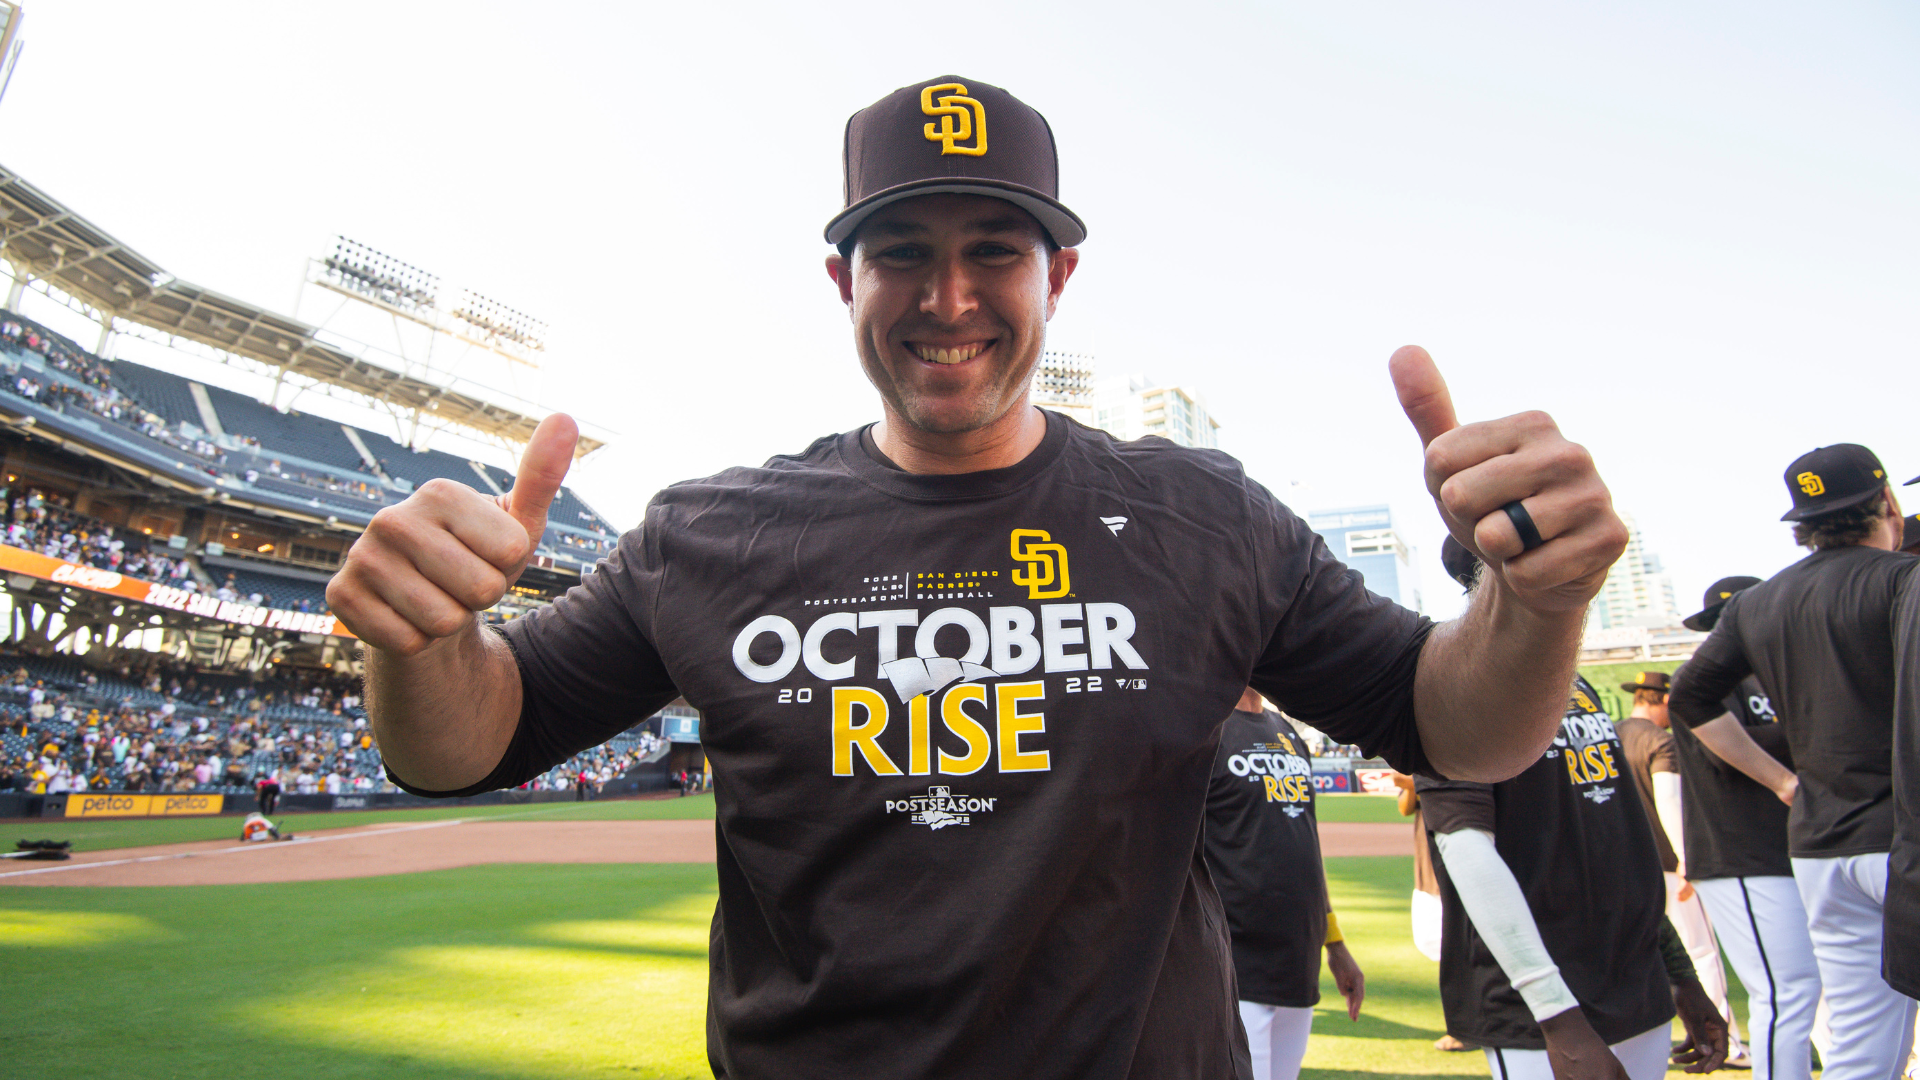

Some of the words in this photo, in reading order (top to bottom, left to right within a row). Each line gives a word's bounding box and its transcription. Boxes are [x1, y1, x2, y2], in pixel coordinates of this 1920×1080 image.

[921, 83, 988, 157] SD
[1797, 471, 1825, 497] SD
[954, 571, 999, 579] DIEGO
[1010, 528, 1070, 599] SD
[144, 582, 190, 610] 2022
[186, 592, 220, 618] SAN
[216, 600, 269, 626] DIEGO
[266, 608, 337, 635] PADRES
[917, 592, 994, 600] BASEBALL
[732, 602, 1149, 683] OCTOBER
[778, 688, 812, 704] 20
[1066, 676, 1103, 693] 22
[831, 680, 1051, 777] RISE
[1564, 742, 1619, 785] RISE
[1263, 776, 1310, 802] RISE
[82, 795, 134, 816] petco
[165, 795, 209, 814] petco
